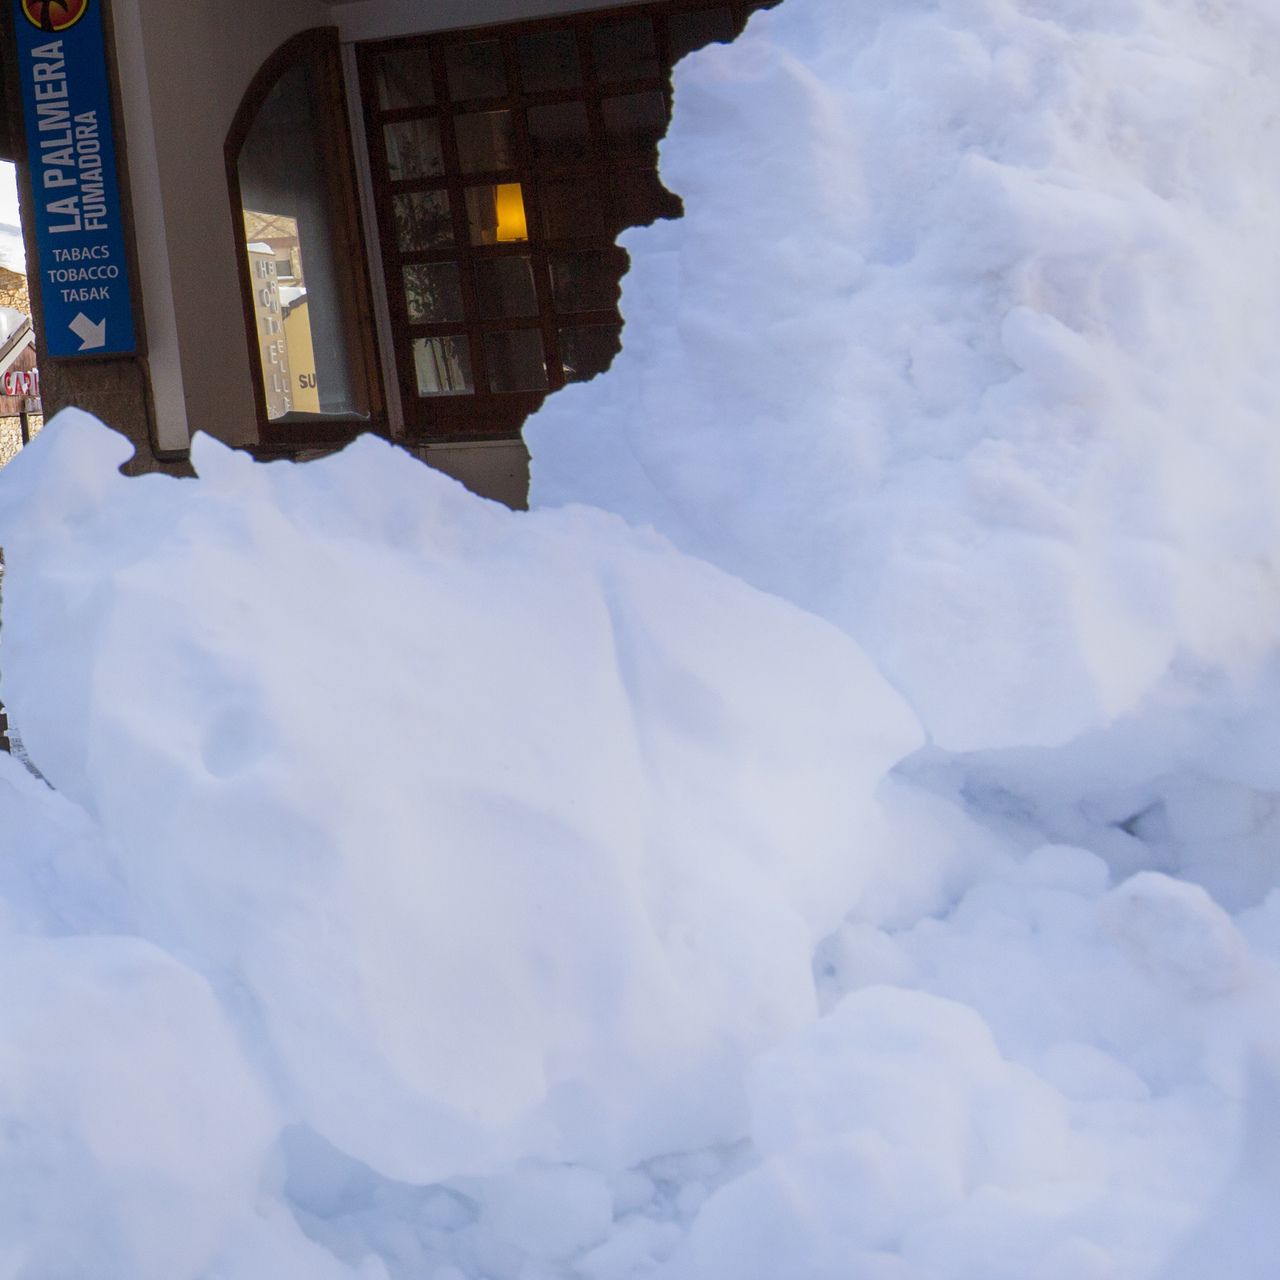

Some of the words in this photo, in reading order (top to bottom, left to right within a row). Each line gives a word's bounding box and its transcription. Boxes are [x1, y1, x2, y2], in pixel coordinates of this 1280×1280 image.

[31, 39, 78, 189] PALMERA
[74, 110, 108, 231] FUMADORA
[46, 195, 82, 233] LA
[52, 245, 110, 262] TABACS
[48, 265, 119, 283] TOBACCO
[61, 286, 110, 302] ТАБАК
